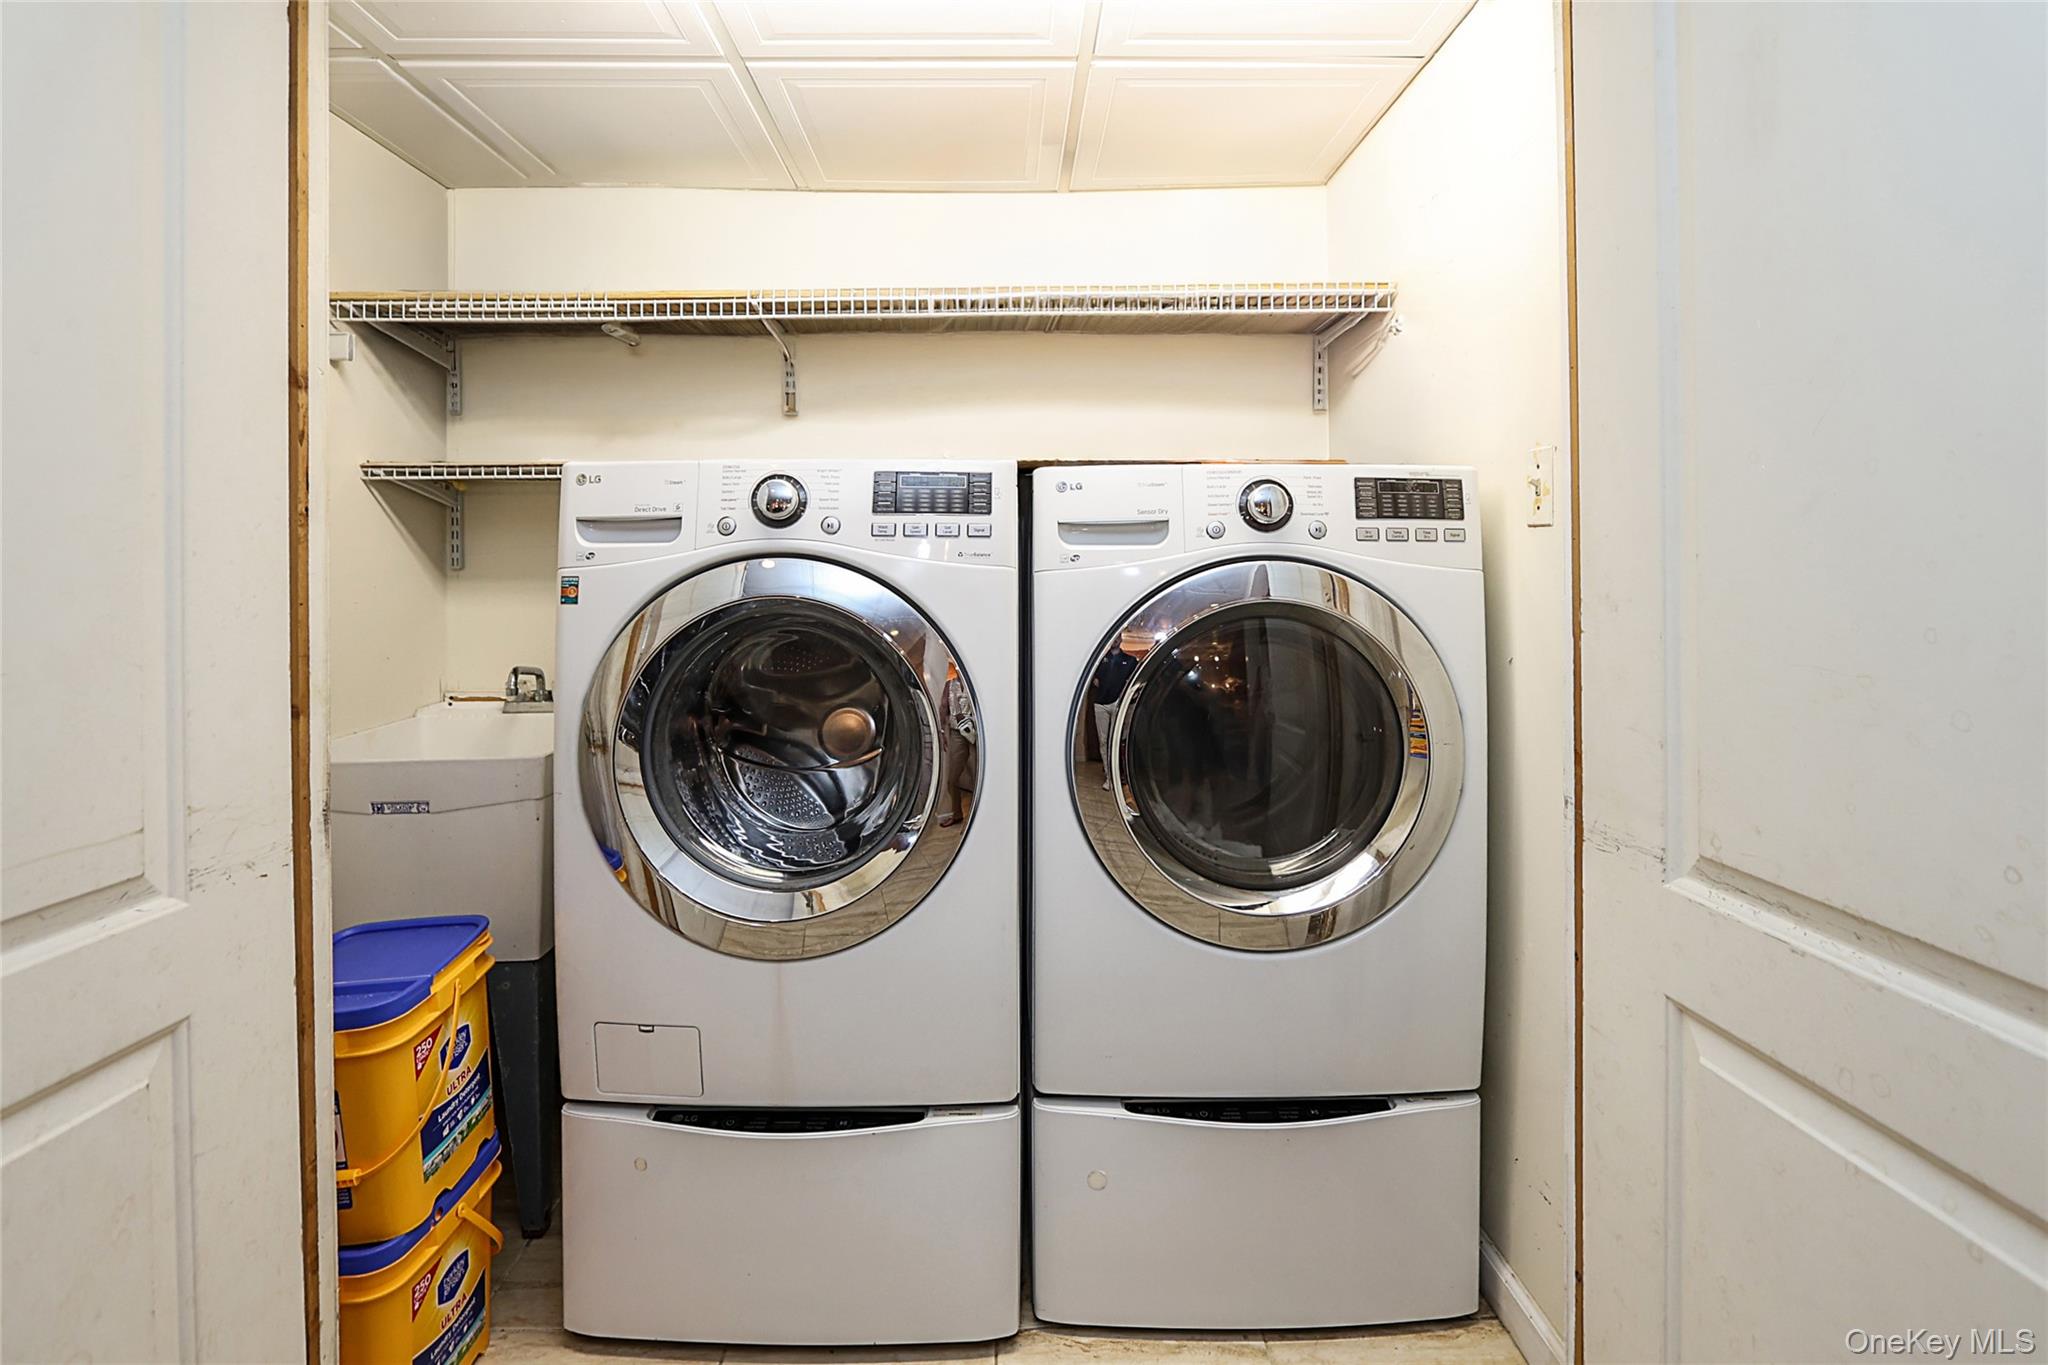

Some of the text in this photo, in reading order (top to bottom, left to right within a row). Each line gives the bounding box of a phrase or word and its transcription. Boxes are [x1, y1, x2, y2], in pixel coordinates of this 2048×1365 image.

[588, 475, 602, 484] LG
[1069, 482, 1083, 491] LG
[416, 1037, 433, 1058] 250
[446, 1065, 472, 1096] ULTRA
[437, 1098, 459, 1123] Laundry
[414, 1273, 432, 1298] 250
[441, 1292, 468, 1330] ULTRA
